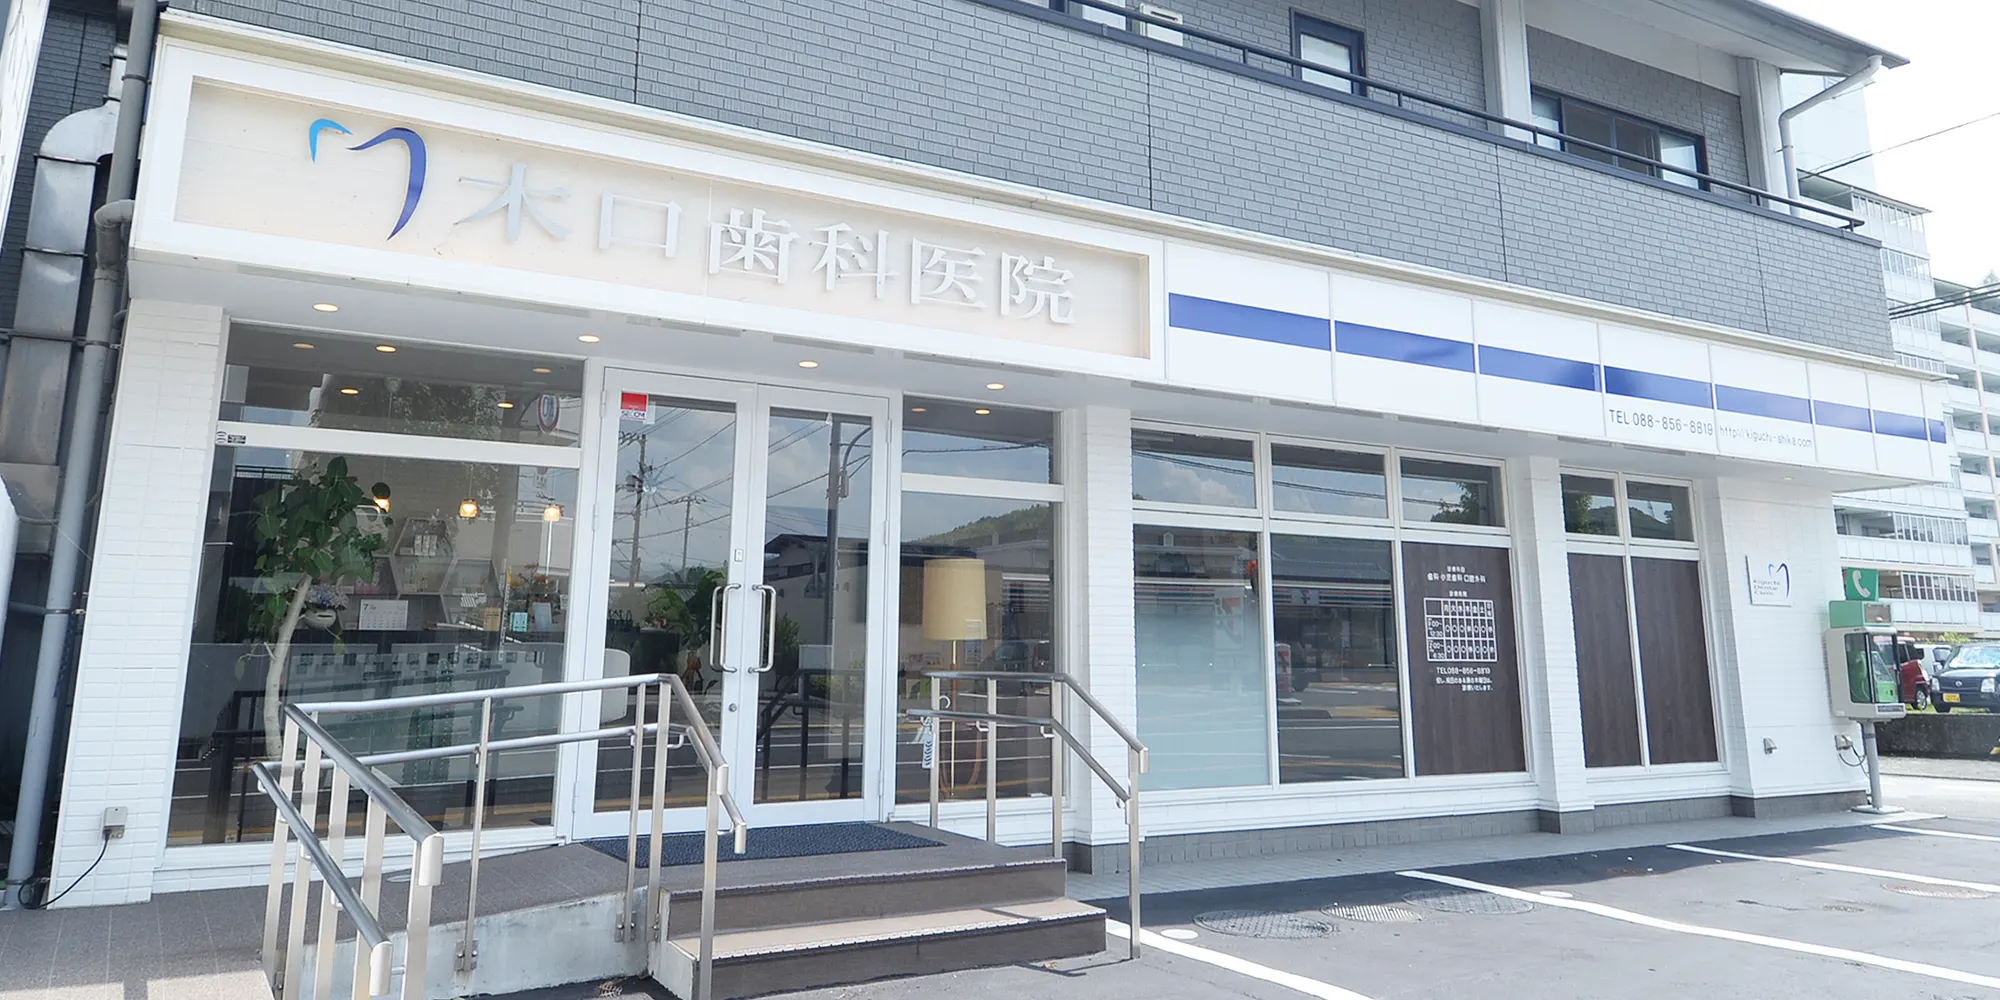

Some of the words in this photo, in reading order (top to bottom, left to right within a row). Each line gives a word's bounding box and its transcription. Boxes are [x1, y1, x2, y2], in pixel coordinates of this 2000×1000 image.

[453, 161, 1075, 325] 木口歯科医院
[1609, 409, 1630, 425] TEL
[1632, 412, 1713, 436] 088-856-8819
